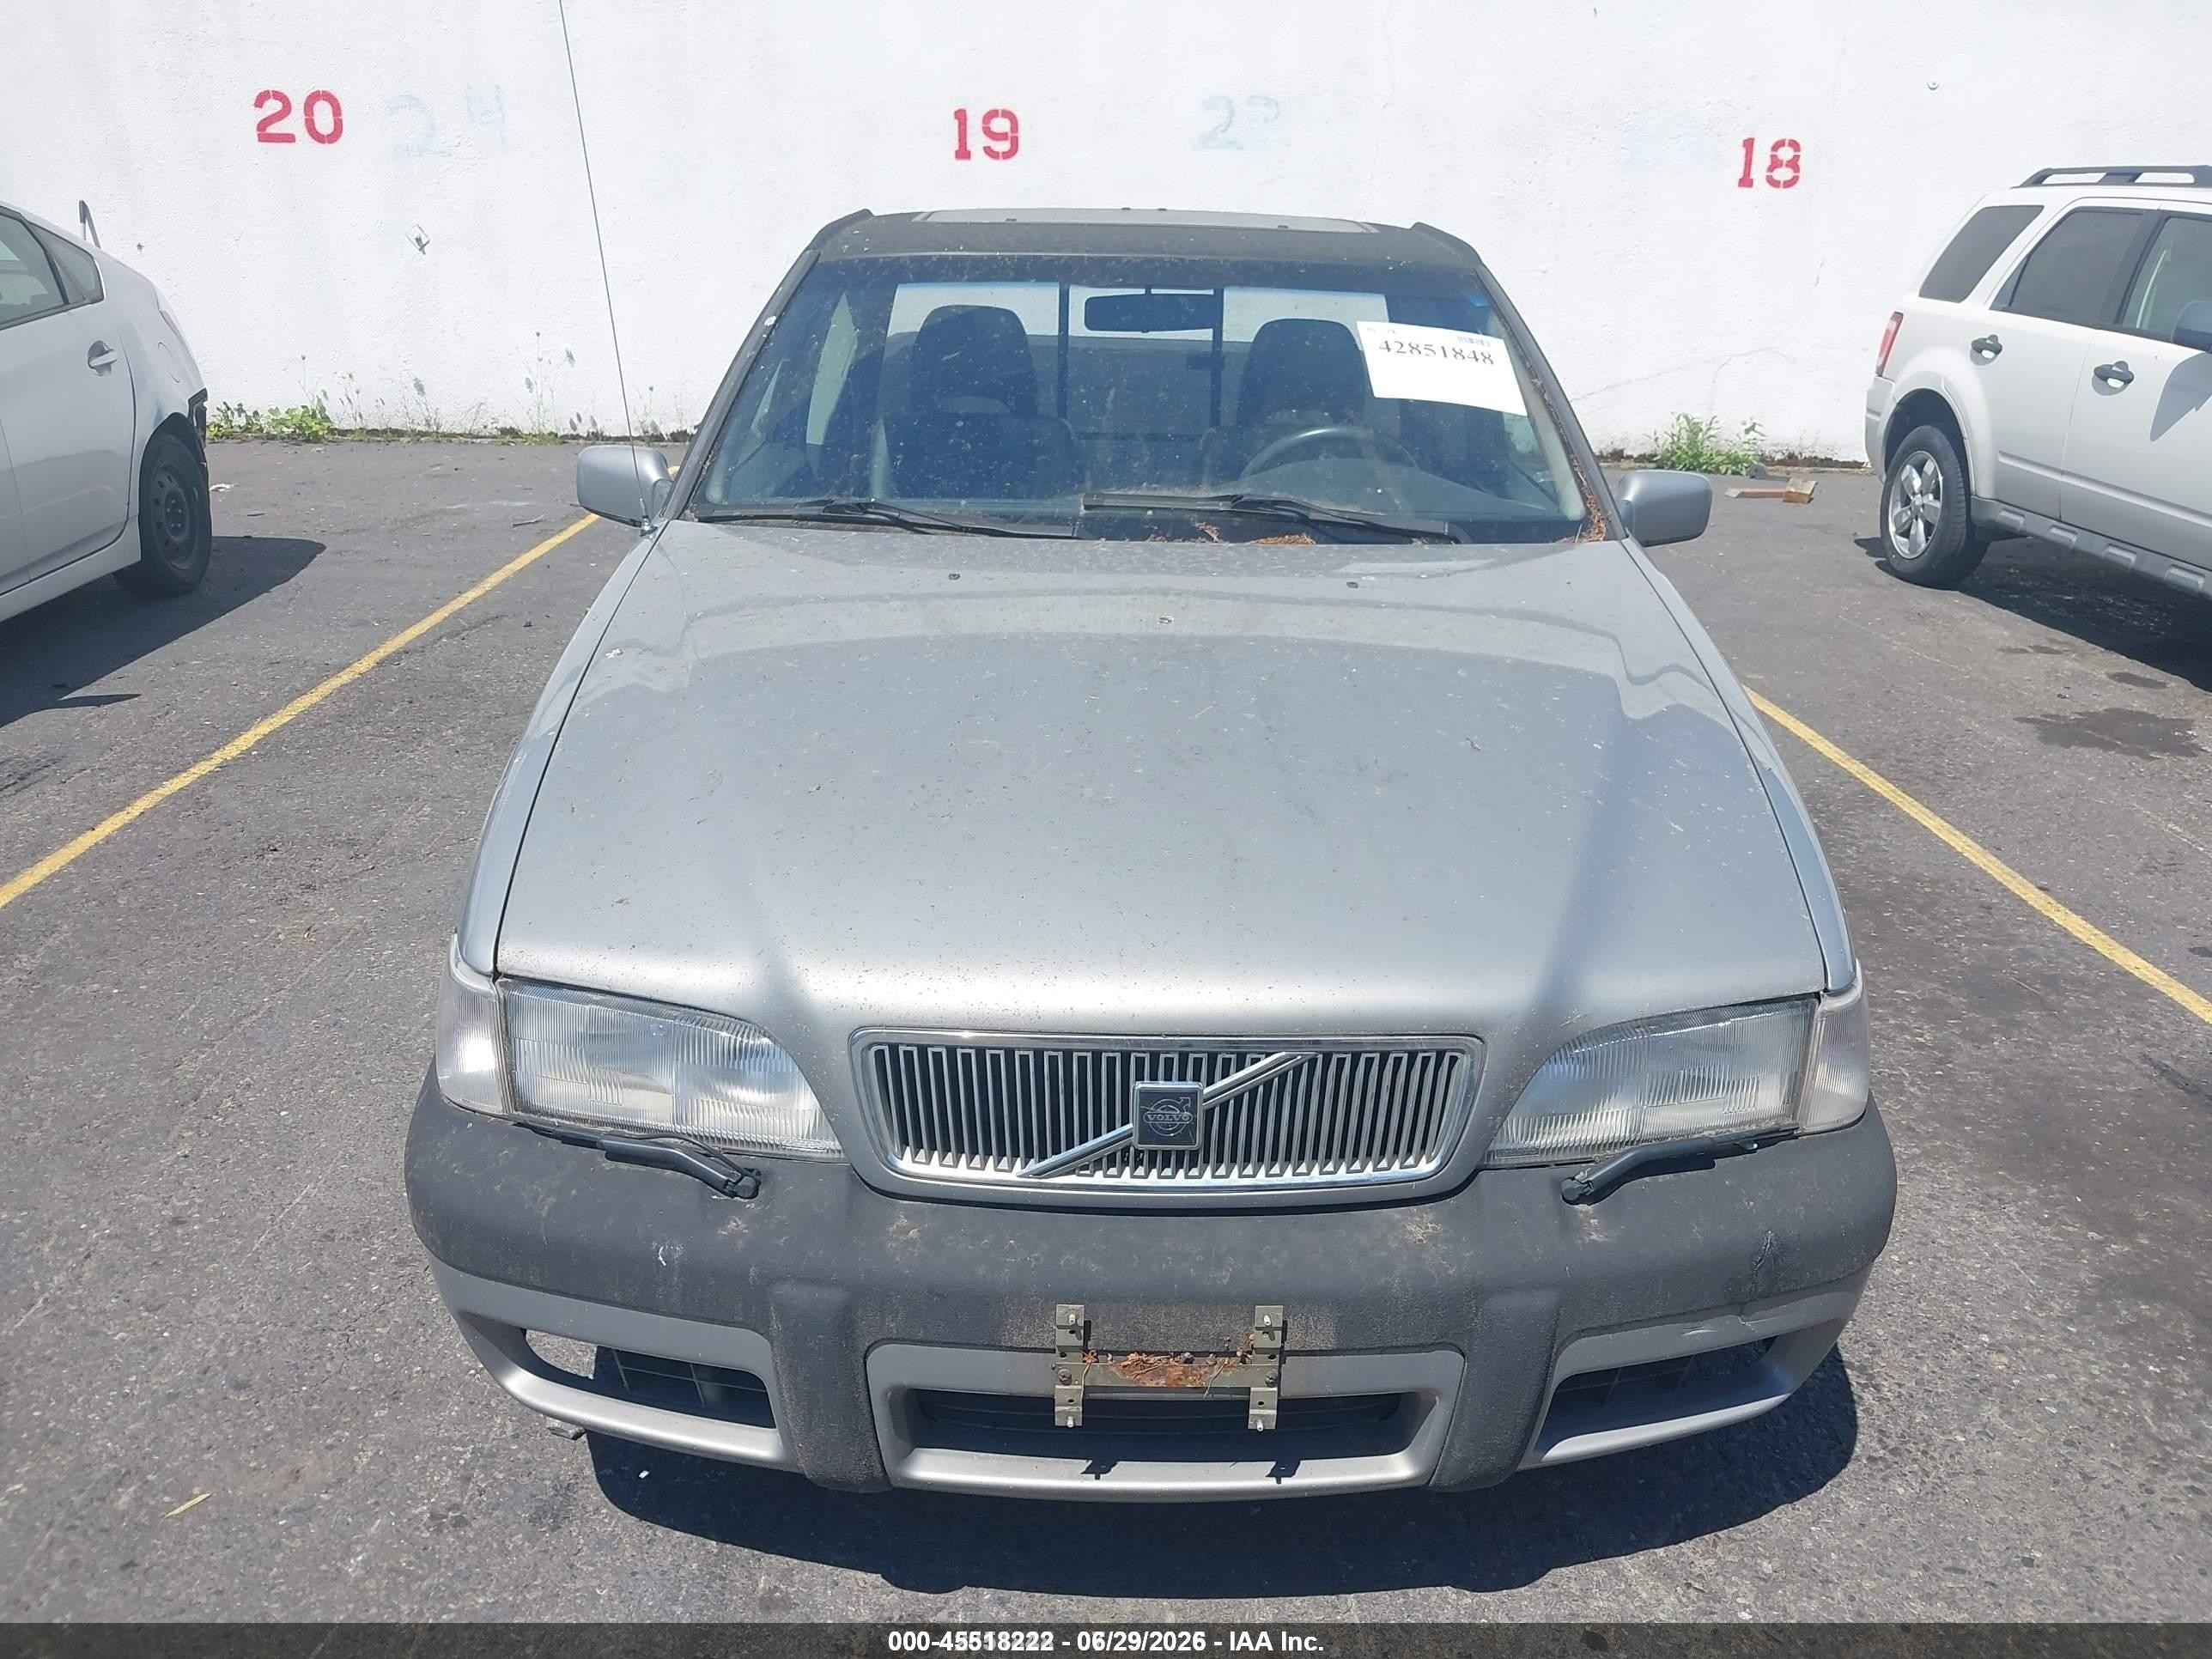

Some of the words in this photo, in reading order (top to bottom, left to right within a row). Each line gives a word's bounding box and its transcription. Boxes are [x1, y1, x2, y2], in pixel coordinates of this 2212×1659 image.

[254, 90, 343, 144] 20
[954, 109, 1019, 161] 19
[1738, 138, 1801, 189] 18
[1379, 340, 1494, 365] 42851848
